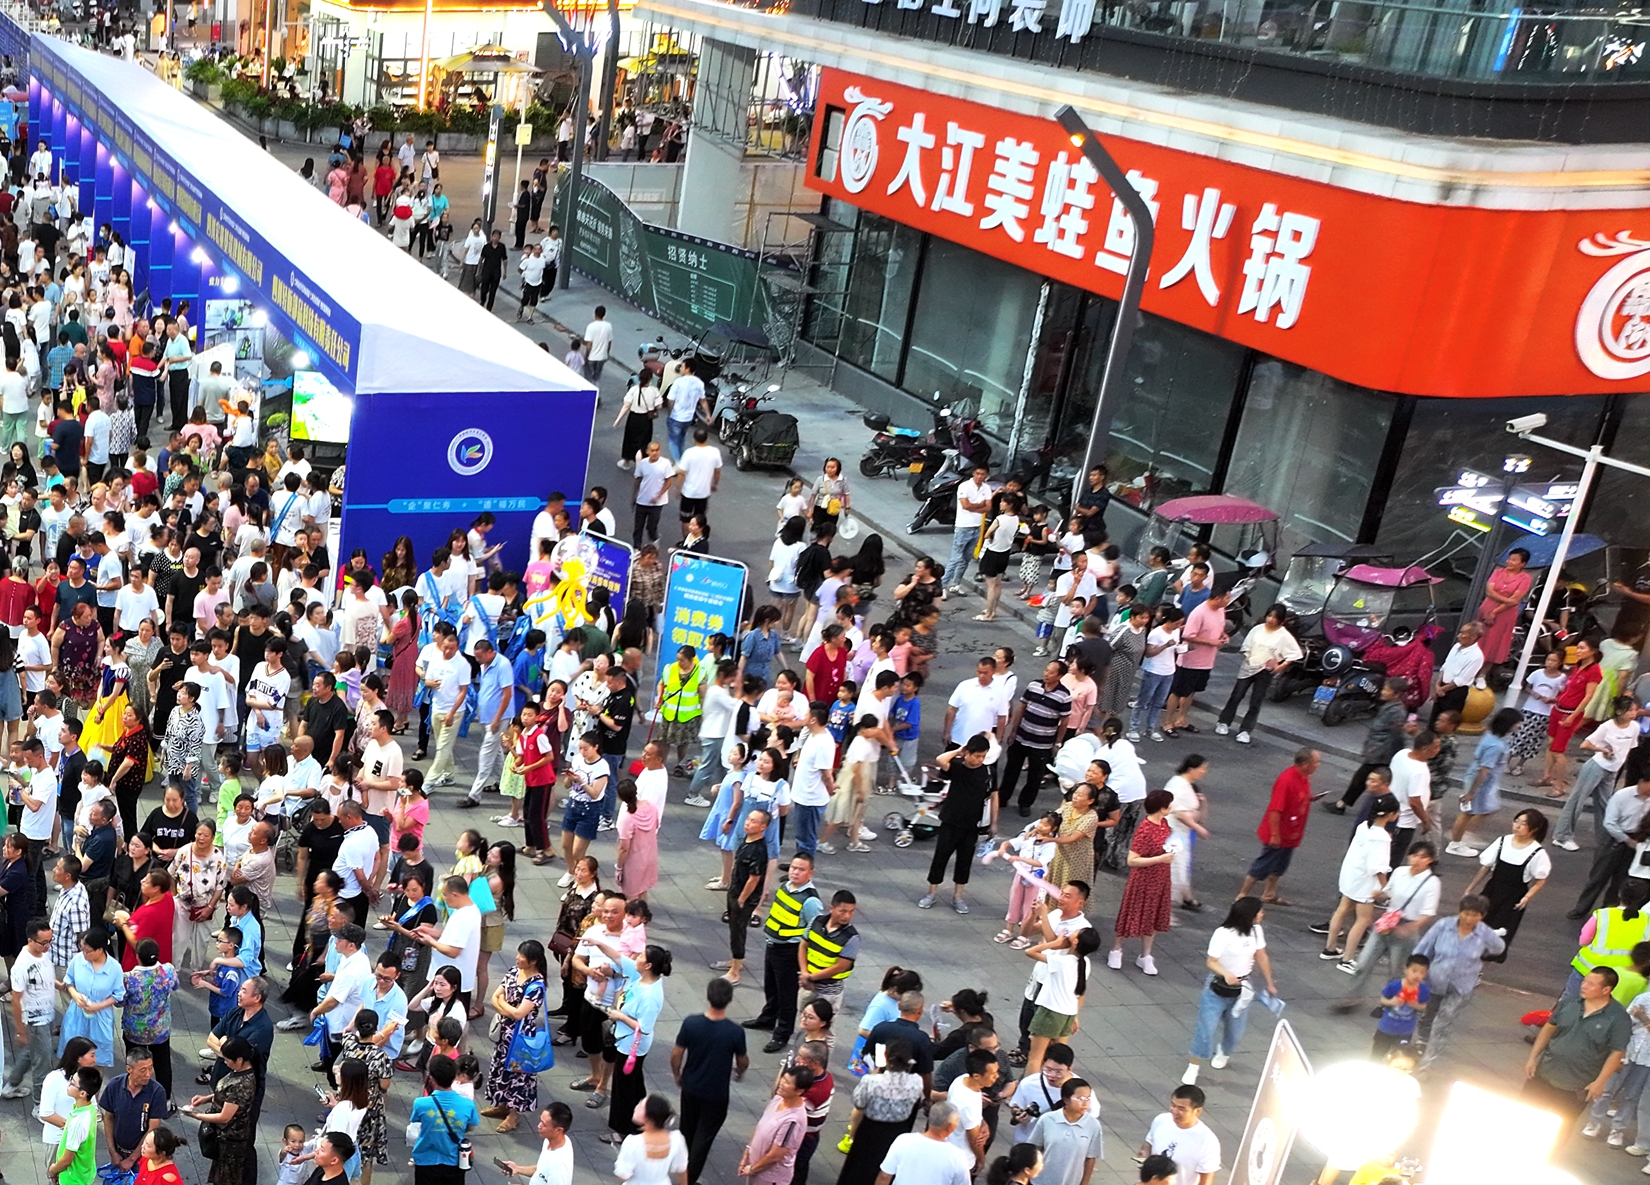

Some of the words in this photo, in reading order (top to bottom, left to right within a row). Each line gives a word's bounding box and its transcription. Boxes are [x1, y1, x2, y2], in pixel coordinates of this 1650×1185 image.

[887, 112, 1321, 330] 大江美蛙鱼火锅
[667, 244, 709, 271] 招贤纳士
[673, 605, 725, 632] 消费券
[157, 827, 185, 838] EYES
